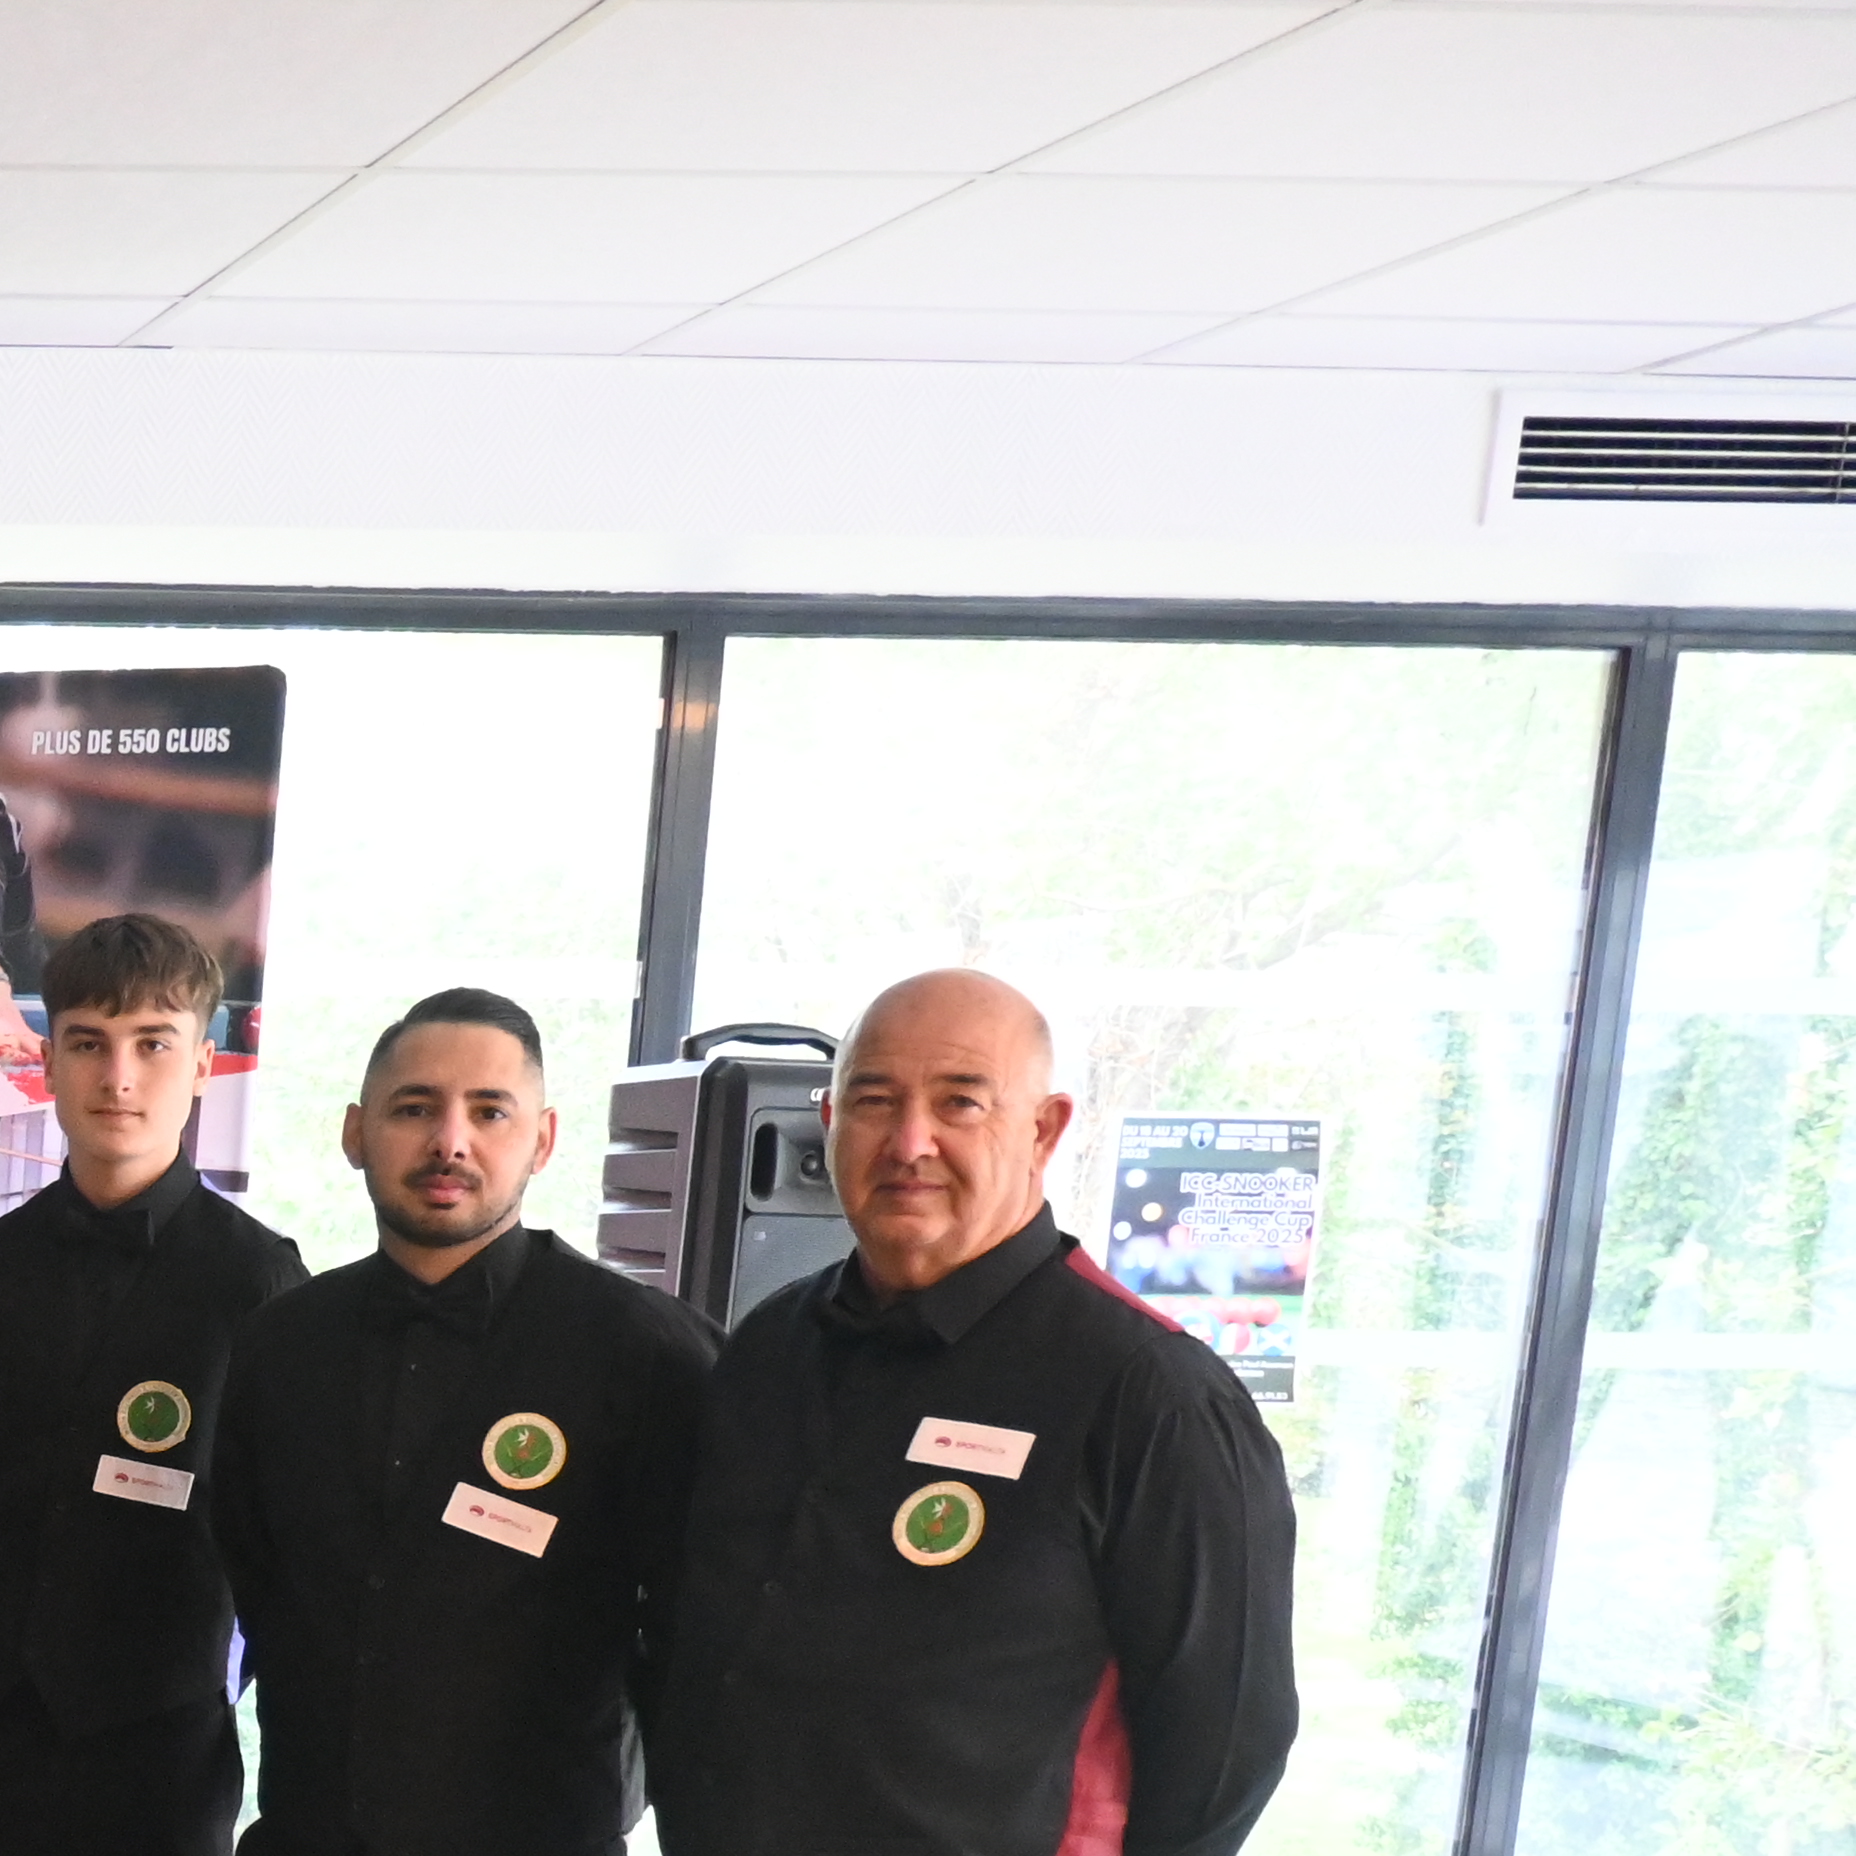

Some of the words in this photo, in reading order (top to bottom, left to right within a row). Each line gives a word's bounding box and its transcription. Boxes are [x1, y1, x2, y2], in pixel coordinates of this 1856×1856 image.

[31, 731, 81, 755] PLUS
[87, 729, 113, 755] DE
[118, 729, 161, 754] 550
[166, 728, 231, 753] CLUBS
[1197, 1193, 1312, 1209] International
[1181, 1210, 1269, 1230] Challenge
[1274, 1210, 1310, 1230] Cup
[1191, 1227, 1250, 1243] France
[1256, 1228, 1304, 1243] 2025
